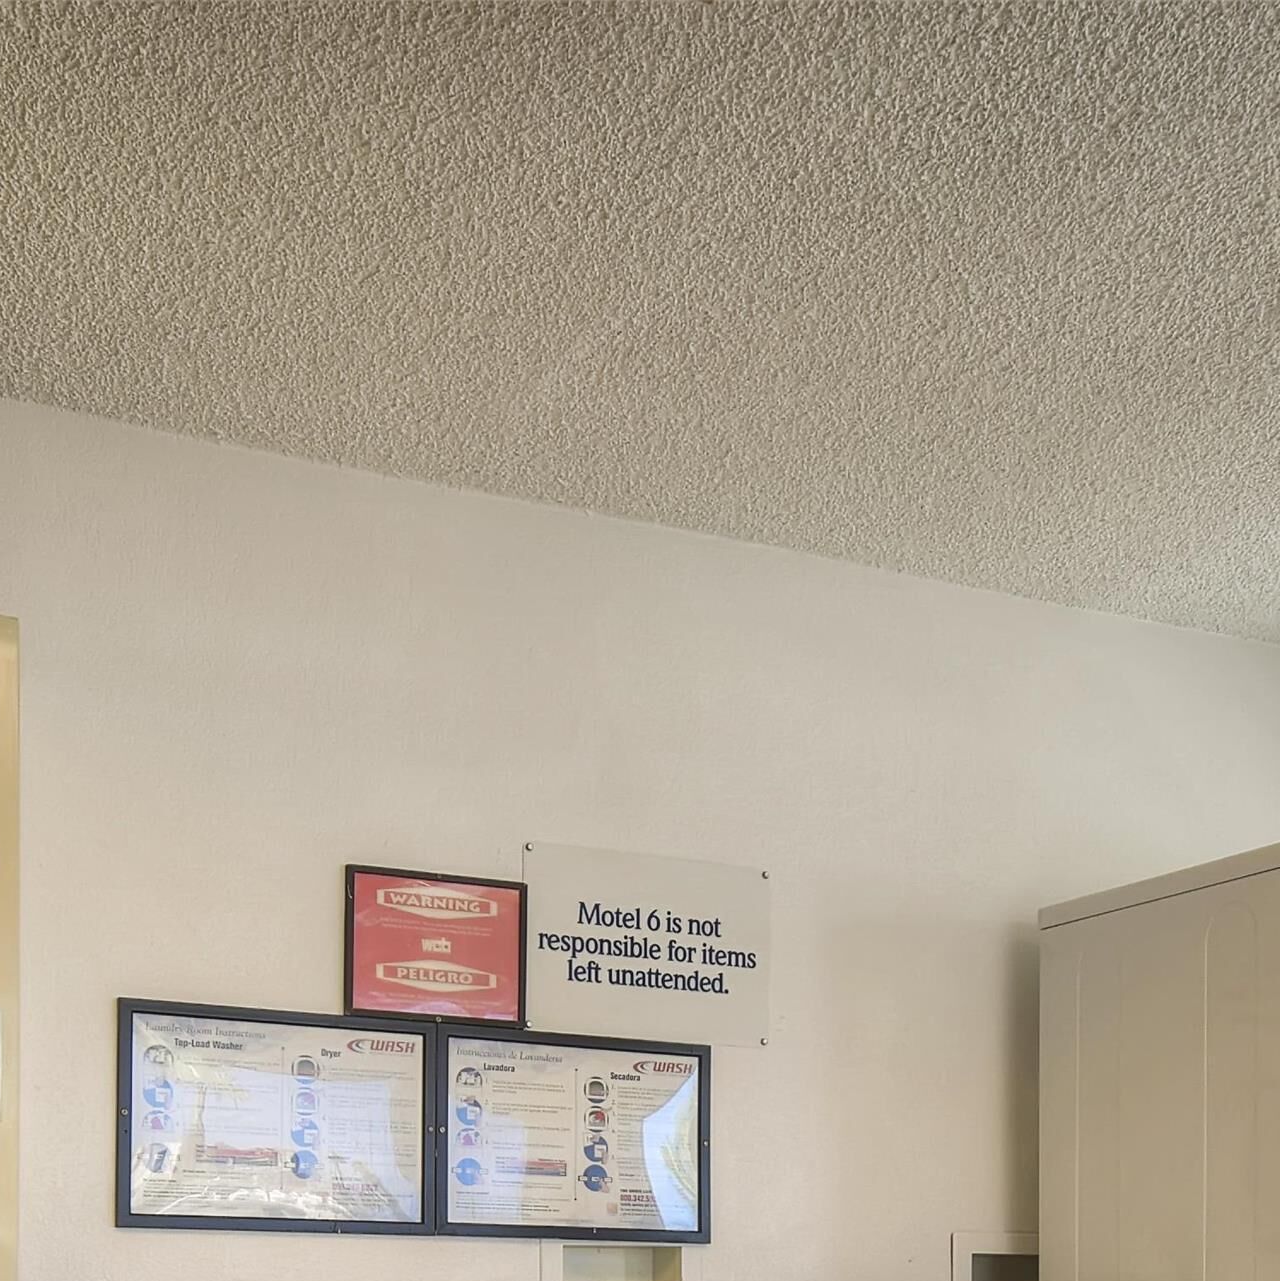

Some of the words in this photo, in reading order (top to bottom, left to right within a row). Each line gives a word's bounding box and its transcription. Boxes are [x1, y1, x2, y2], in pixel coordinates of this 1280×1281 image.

[389, 892, 481, 913] WARNING
[577, 901, 642, 930] Motel
[647, 909, 661, 931] 6
[666, 911, 682, 933] is
[687, 917, 722, 937] not
[421, 937, 452, 953] web
[538, 932, 661, 960] responsible
[667, 939, 697, 963] for
[701, 942, 757, 969] items
[396, 966, 473, 984] PELIGRO
[567, 959, 602, 983] left
[607, 966, 729, 994] unattended.
[215, 1027, 266, 1039] Instructions
[174, 1038, 211, 1048] Top-Load
[212, 1041, 243, 1051] Washer
[369, 1039, 416, 1054] WASH
[320, 1048, 342, 1059] Dryer
[483, 1062, 516, 1073] Lavadora
[652, 1061, 693, 1074] WASH
[610, 1072, 641, 1081] Secadora
